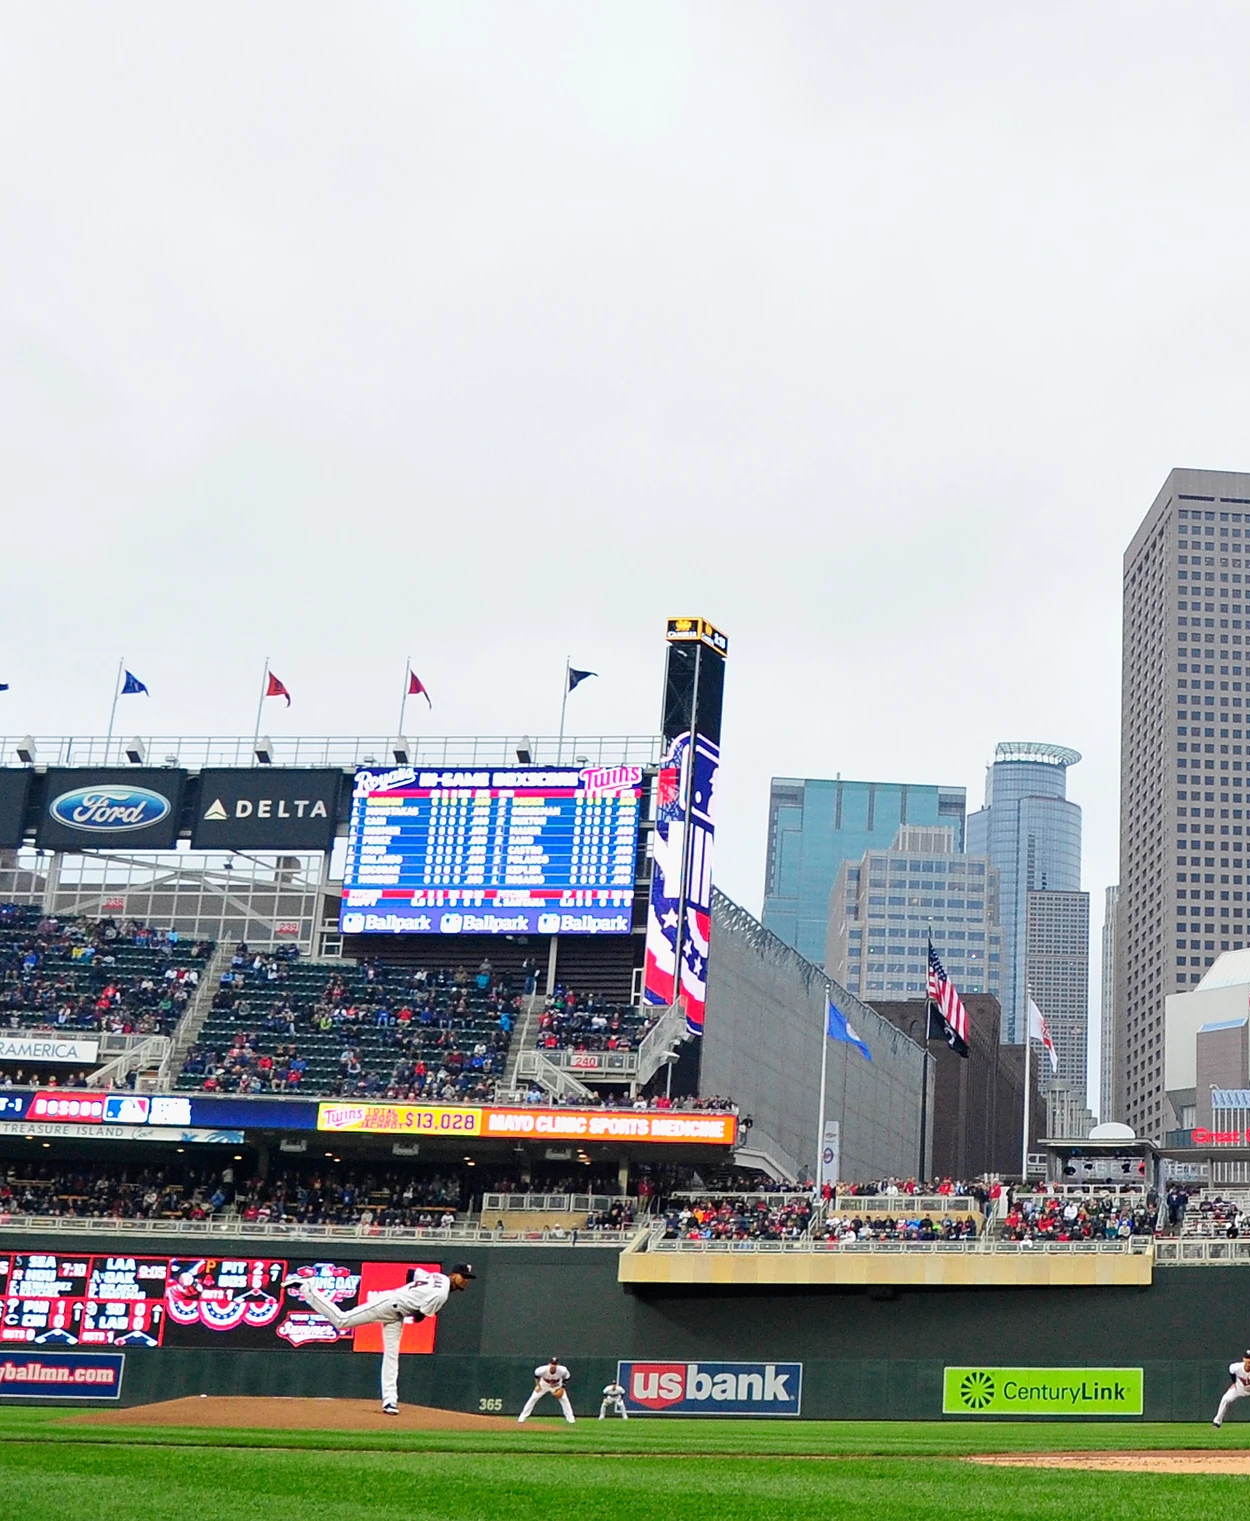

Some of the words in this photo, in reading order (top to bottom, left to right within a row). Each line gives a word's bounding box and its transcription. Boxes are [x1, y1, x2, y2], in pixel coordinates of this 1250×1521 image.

[579, 767, 642, 788] Twins
[73, 792, 146, 823] Ford
[235, 799, 328, 818] DELTA
[364, 914, 432, 933] Ballpark
[462, 914, 530, 933] Ballpark
[559, 915, 629, 934] Ballpark
[575, 1056, 597, 1066] 240
[323, 1107, 363, 1127] Twins
[405, 1111, 476, 1131] $13,028
[4, 1123, 70, 1136] TREASURE
[76, 1124, 124, 1137] ISLAND
[488, 1113, 535, 1132] MAYO
[535, 1115, 588, 1134] CLINIC
[588, 1117, 650, 1136] SPORTS
[650, 1118, 725, 1139] MEDICINE
[1192, 1127, 1240, 1144] Great
[28, 1255, 57, 1268] SEA
[106, 1257, 137, 1271] LAA
[221, 1261, 248, 1274] PIT
[253, 1261, 264, 1274] 2
[251, 1274, 263, 1289] 5
[225, 1289, 234, 1301] 1
[57, 1300, 66, 1314] 1
[106, 1331, 115, 1344] 1
[1003, 1381, 1126, 1405] CenturyLink
[478, 1398, 503, 1412] 365
